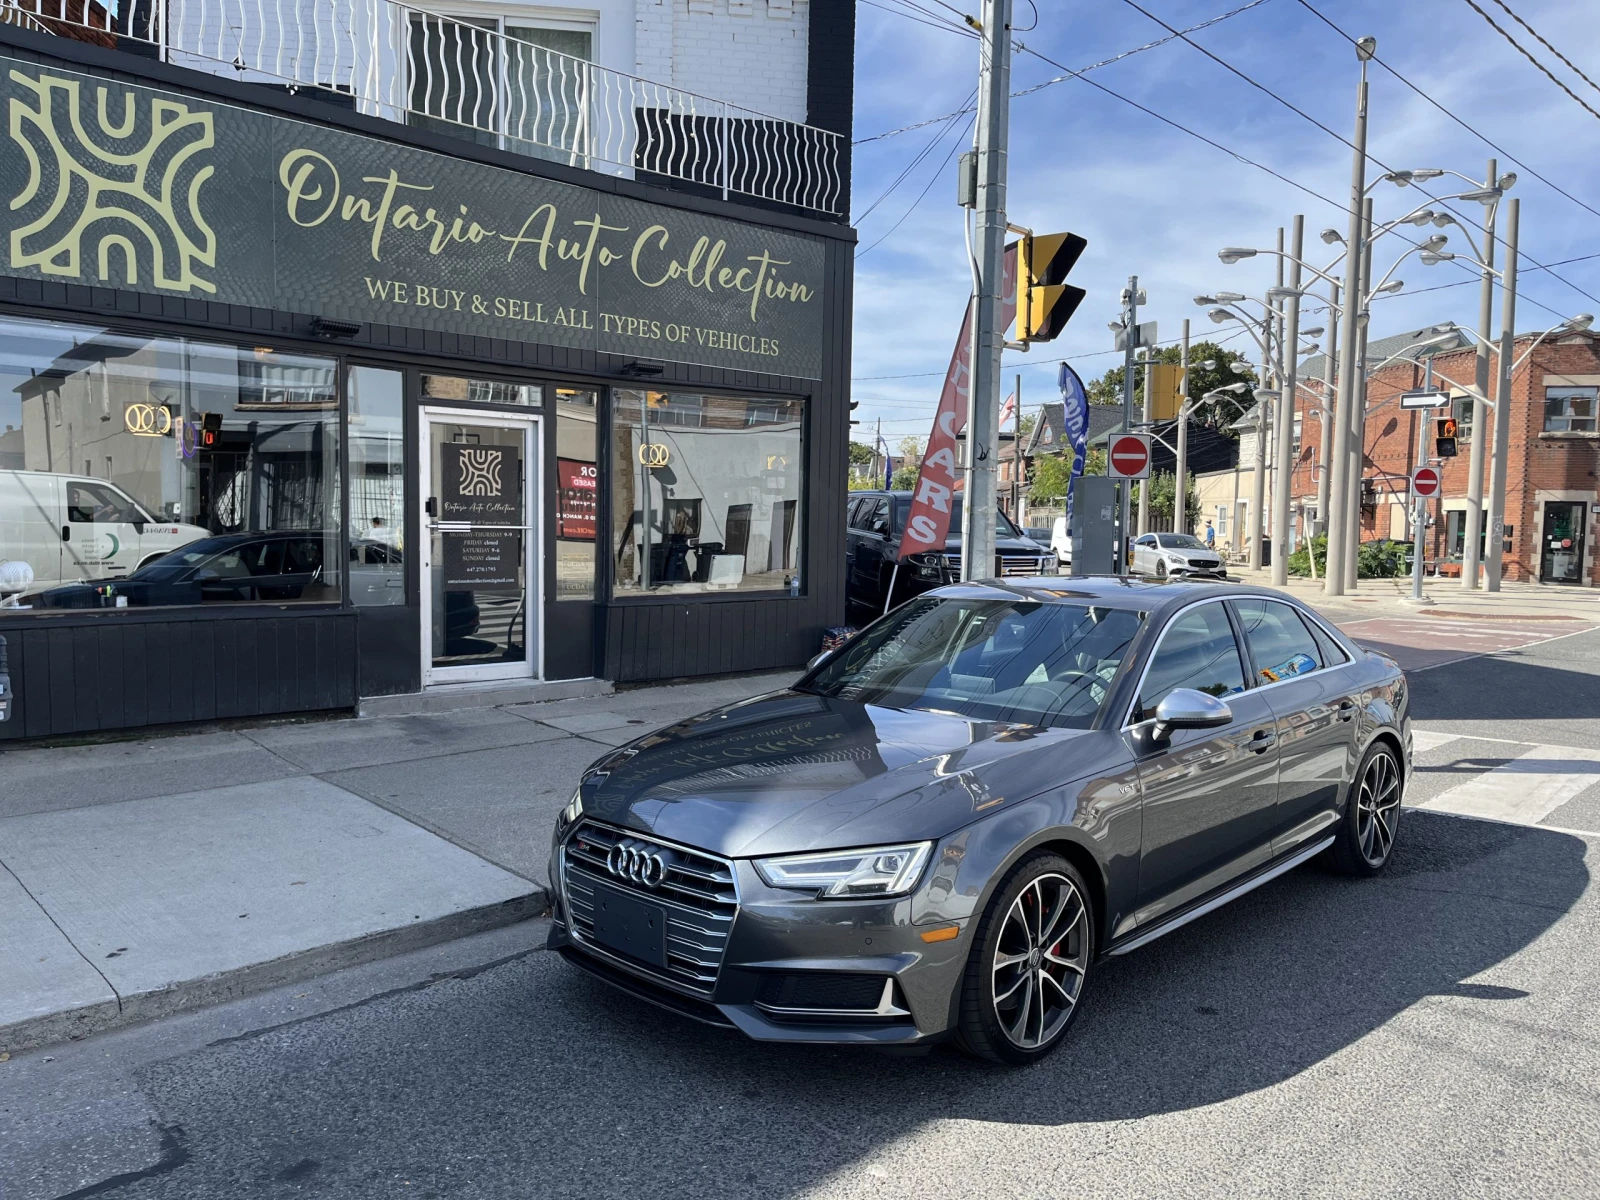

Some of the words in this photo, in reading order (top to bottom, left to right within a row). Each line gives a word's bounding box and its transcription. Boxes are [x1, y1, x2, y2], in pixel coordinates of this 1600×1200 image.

[279, 148, 496, 262] Ontario
[499, 203, 630, 295] Auto
[631, 225, 814, 323] Collection
[364, 277, 409, 304] WE
[415, 285, 466, 311] BUY
[471, 294, 489, 315] &
[494, 297, 549, 323] SELL
[553, 306, 594, 330] ALL
[600, 313, 661, 339] TYPES
[665, 323, 690, 343] OF
[695, 328, 780, 356] VEHICLES
[444, 501, 467, 514] Ontario
[469, 502, 484, 513] Auto
[486, 503, 516, 514] Collection
[908, 411, 956, 544] CARS
[1118, 783, 1135, 794] V6T
